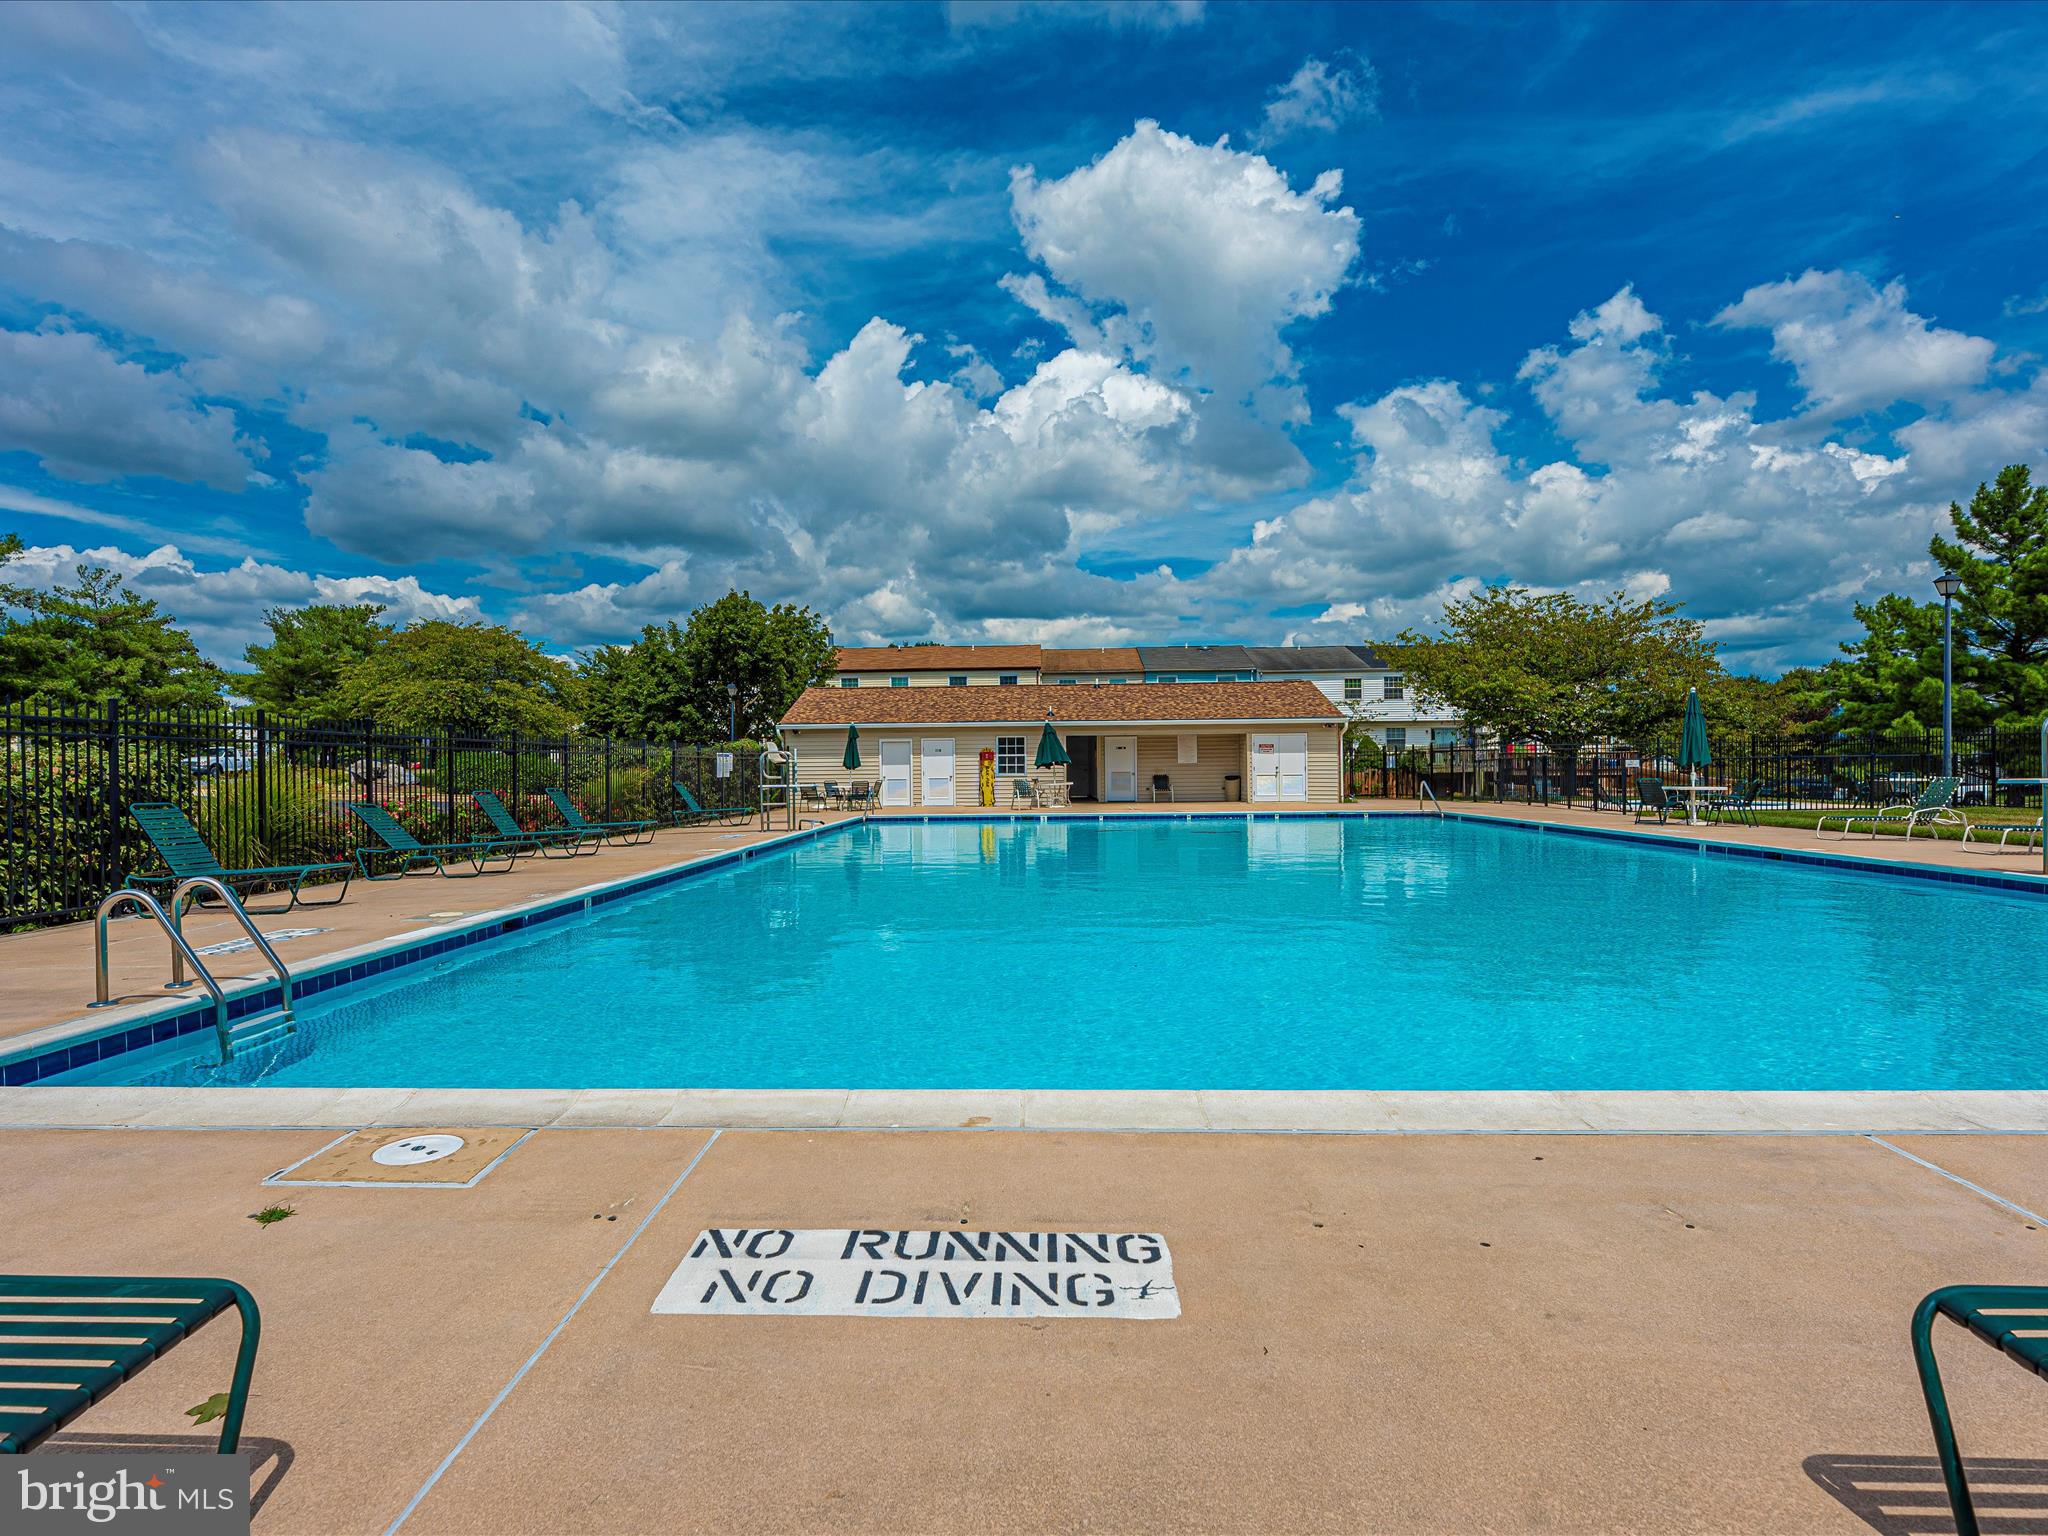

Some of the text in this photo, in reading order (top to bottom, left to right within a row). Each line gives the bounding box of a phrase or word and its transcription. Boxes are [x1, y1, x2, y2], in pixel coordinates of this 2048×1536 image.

[691, 1229, 1162, 1263] NO RUNNING
[700, 1269, 1115, 1306] NO DIVING
